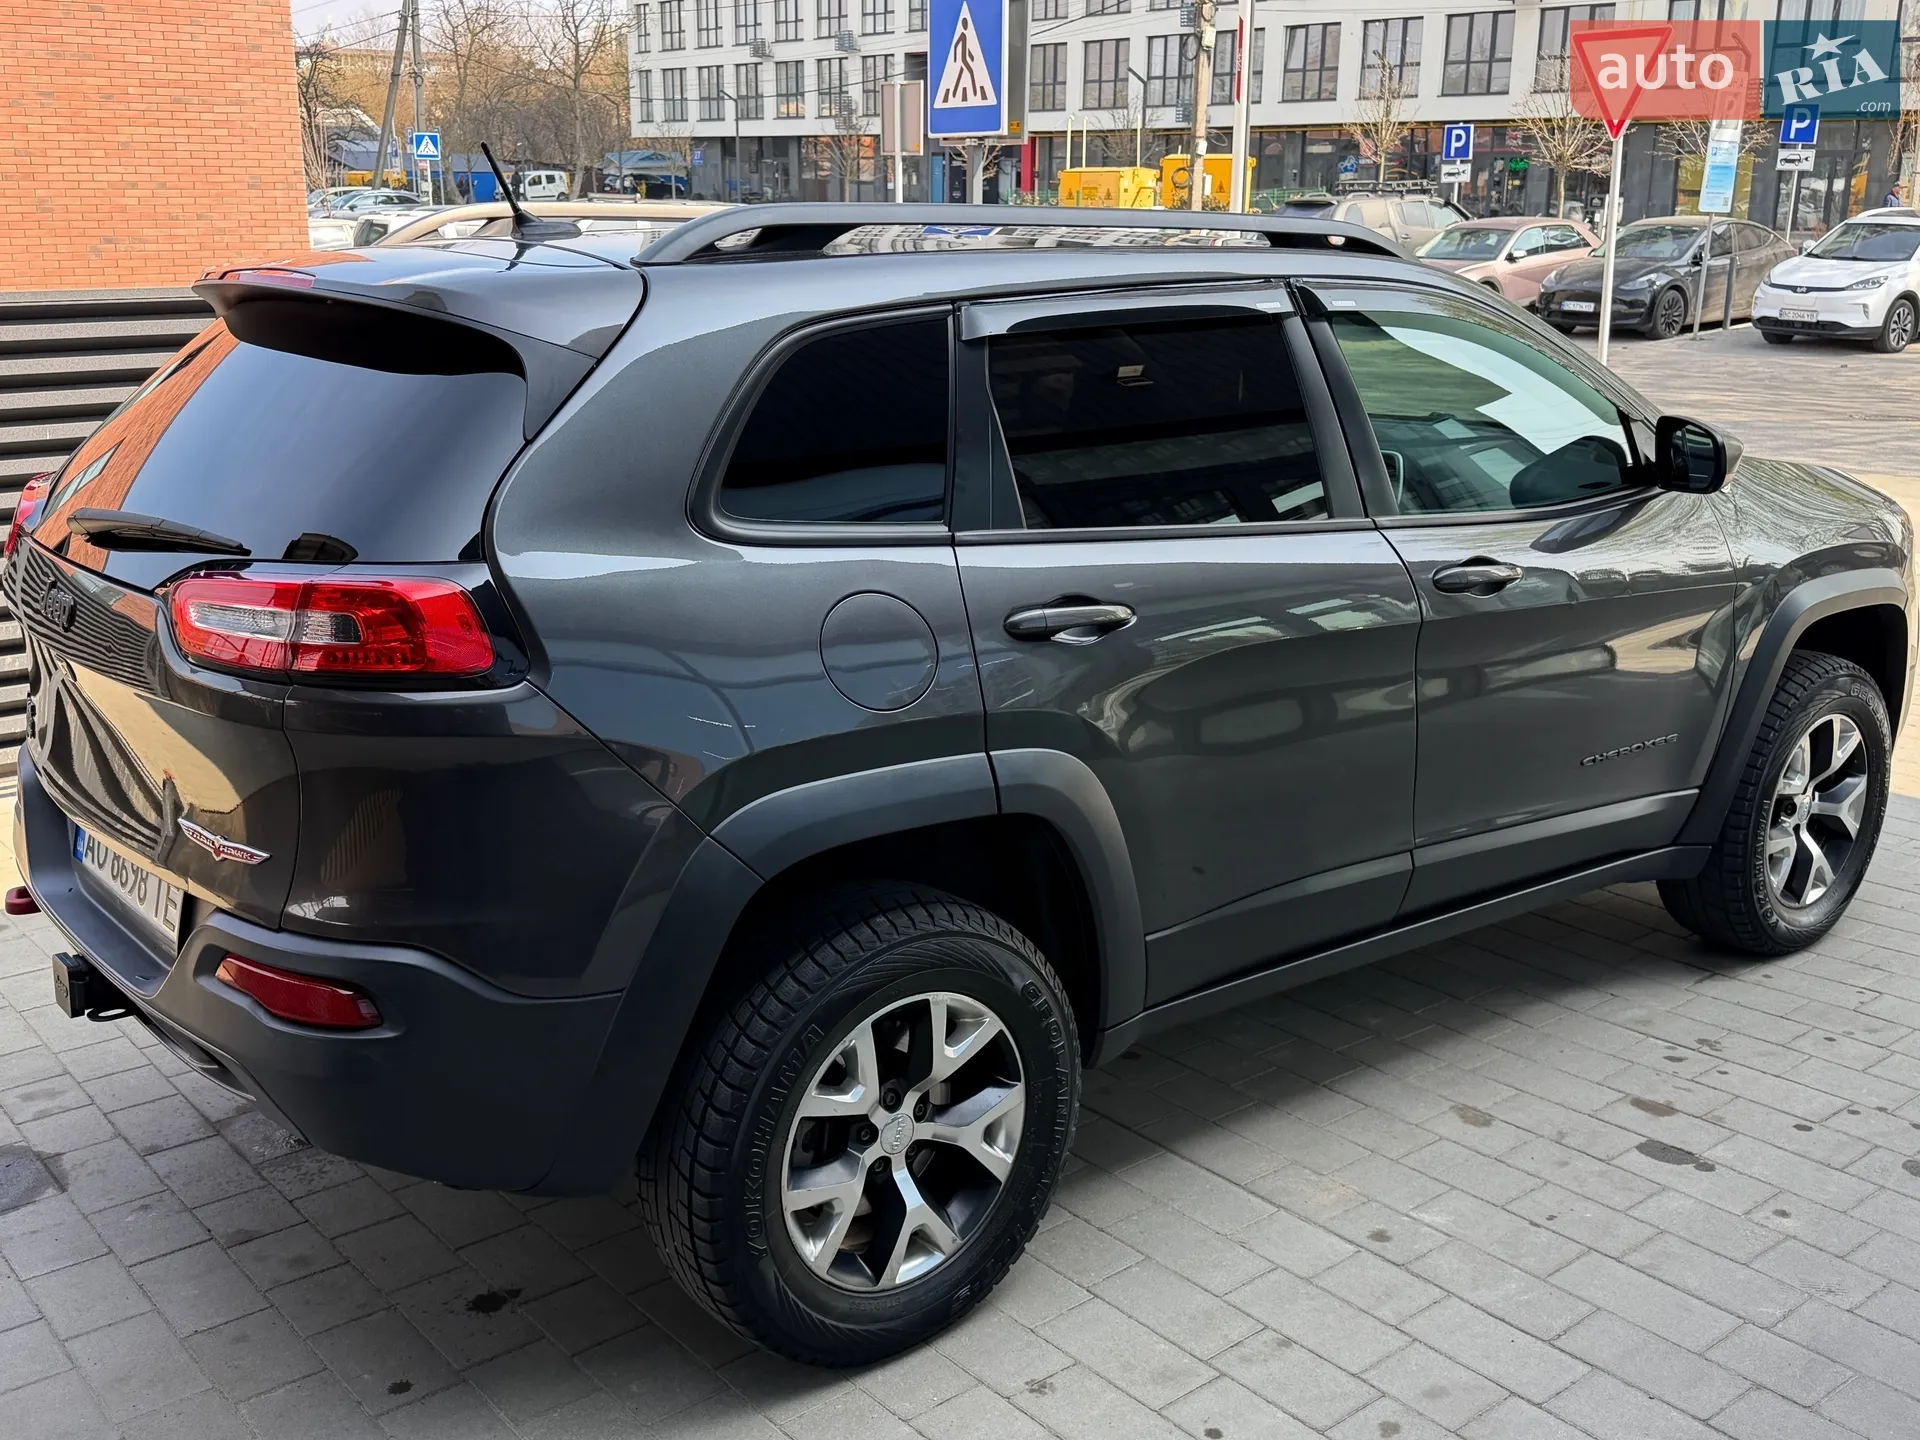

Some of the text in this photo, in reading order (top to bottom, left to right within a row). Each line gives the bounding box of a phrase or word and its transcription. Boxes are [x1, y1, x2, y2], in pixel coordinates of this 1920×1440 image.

[1789, 107, 1811, 139] P
[1450, 129, 1466, 157] P
[1580, 733, 1678, 767] CHEROKEE
